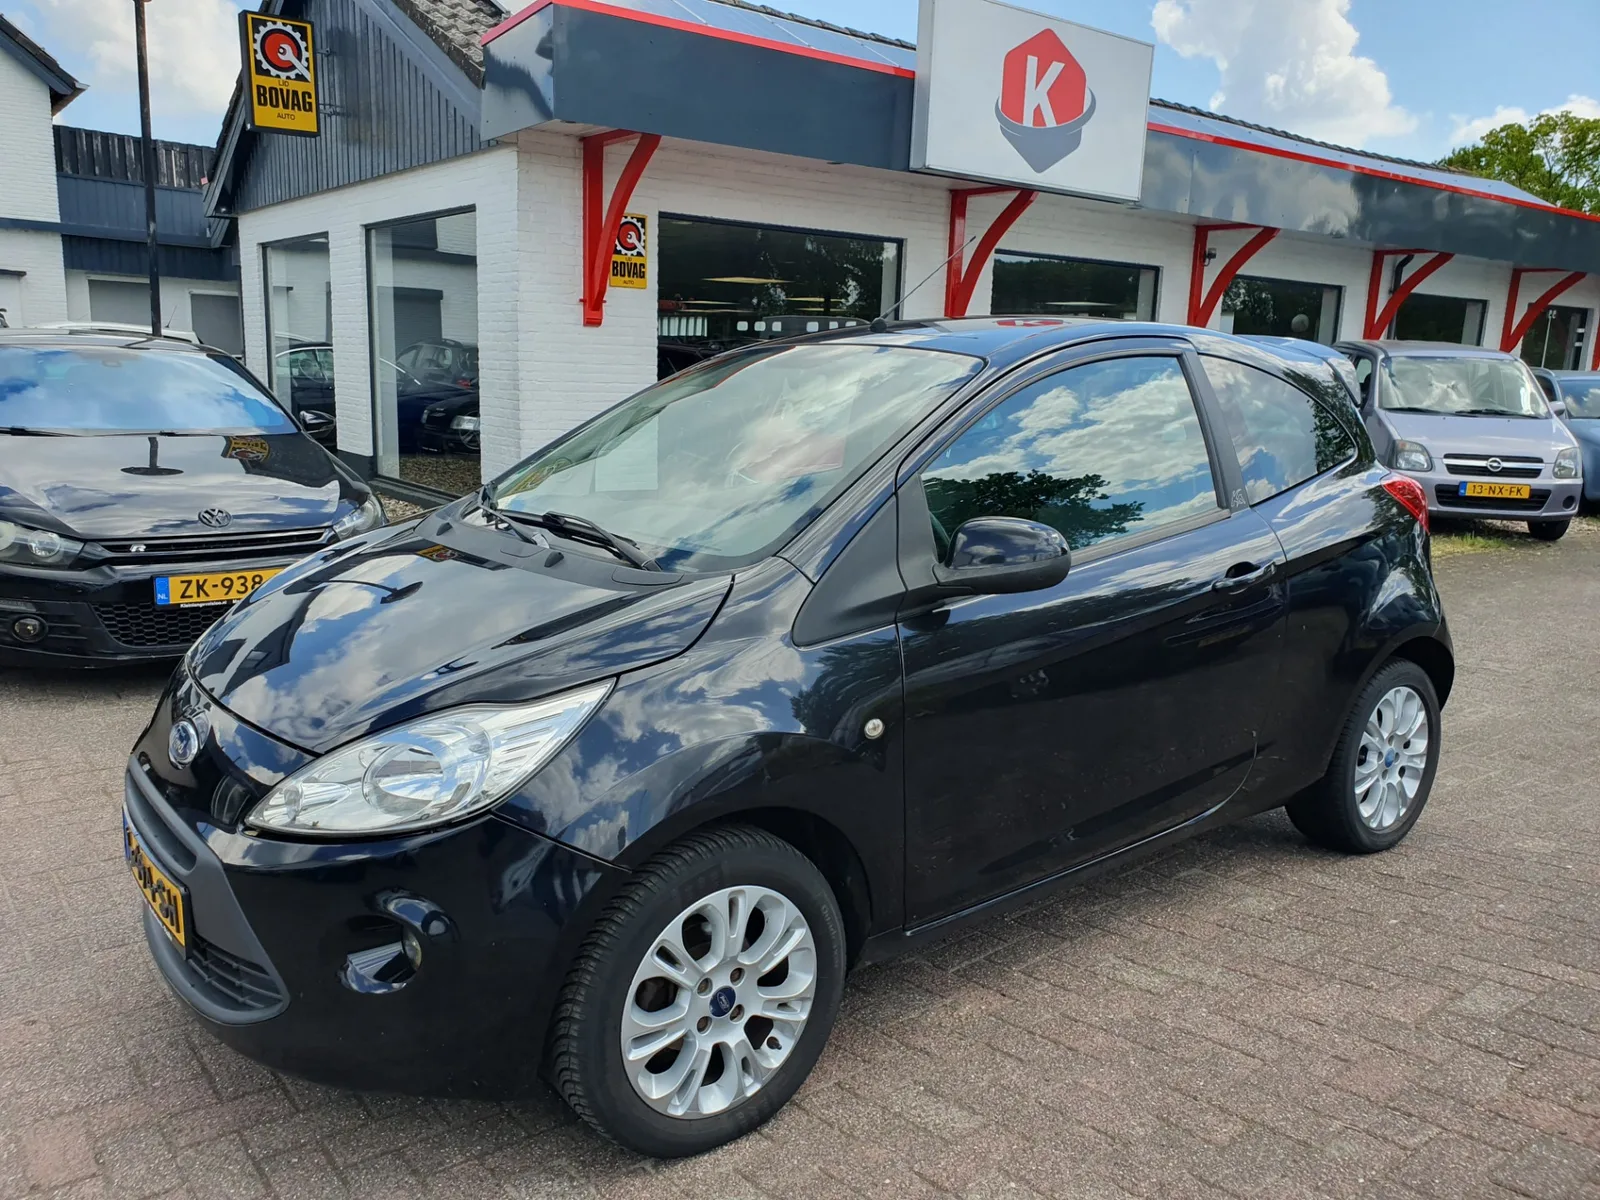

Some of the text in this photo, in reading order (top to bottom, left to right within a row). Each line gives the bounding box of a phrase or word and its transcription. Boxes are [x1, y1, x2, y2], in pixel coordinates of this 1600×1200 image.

[256, 84, 313, 112] BOVAG
[1022, 54, 1066, 128] K
[277, 112, 296, 120] AUTO
[612, 260, 646, 279] BOVAG
[1472, 485, 1522, 496] 13-NX-FK
